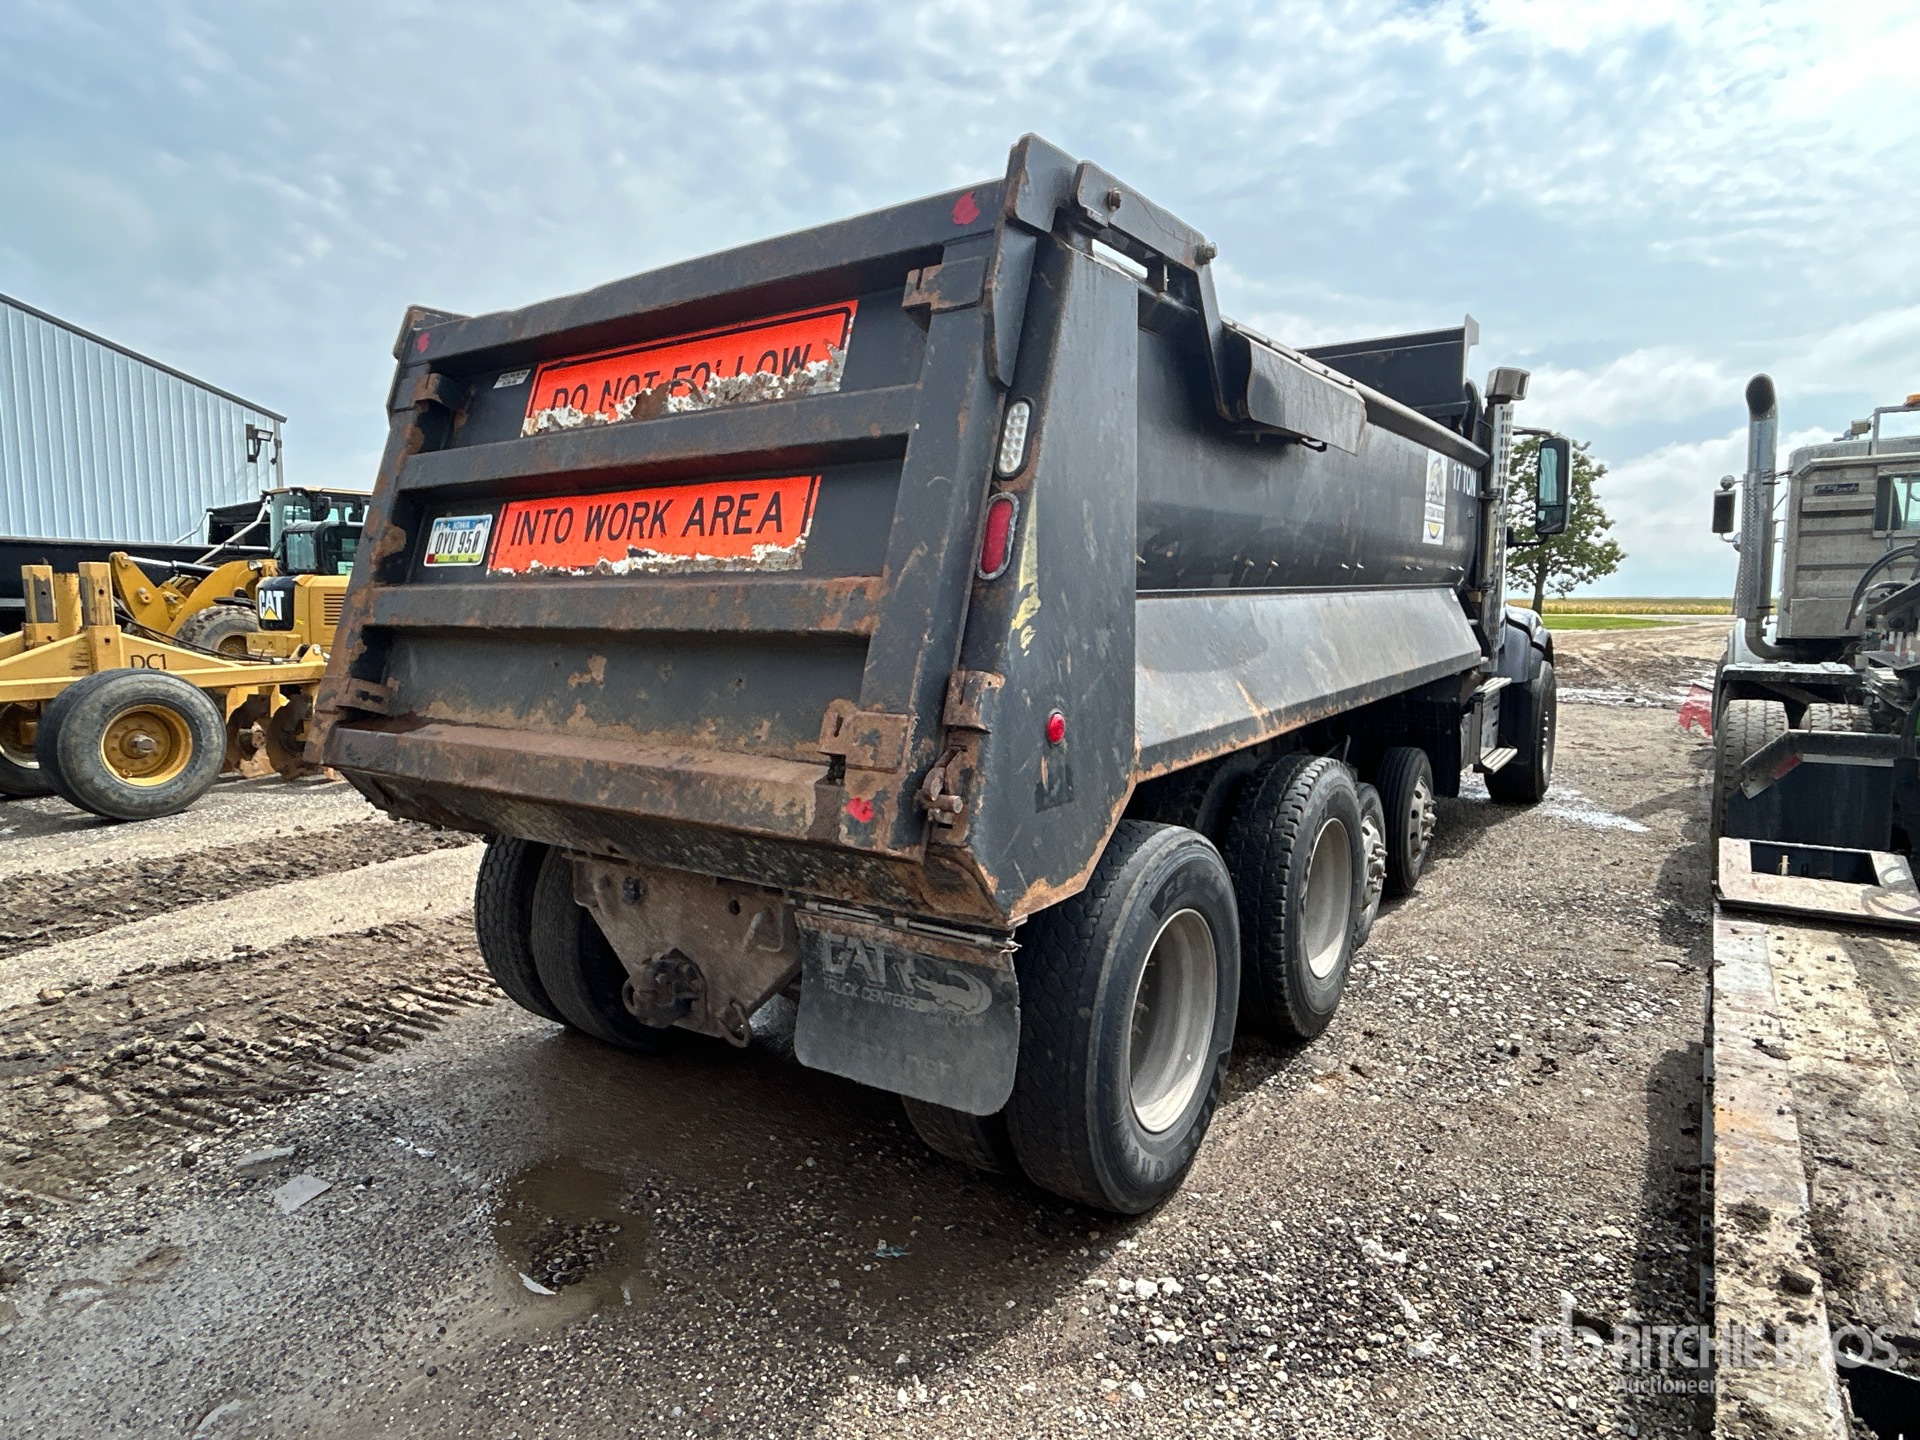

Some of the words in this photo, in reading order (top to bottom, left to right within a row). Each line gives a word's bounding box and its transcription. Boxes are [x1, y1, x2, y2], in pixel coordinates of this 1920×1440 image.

[1453, 462, 1462, 491] 17
[1463, 465, 1477, 497] TON
[510, 507, 574, 546] INTO
[584, 499, 675, 543] WORK
[681, 491, 783, 538] AREA
[258, 589, 285, 621] CAT
[130, 653, 167, 670] DC1
